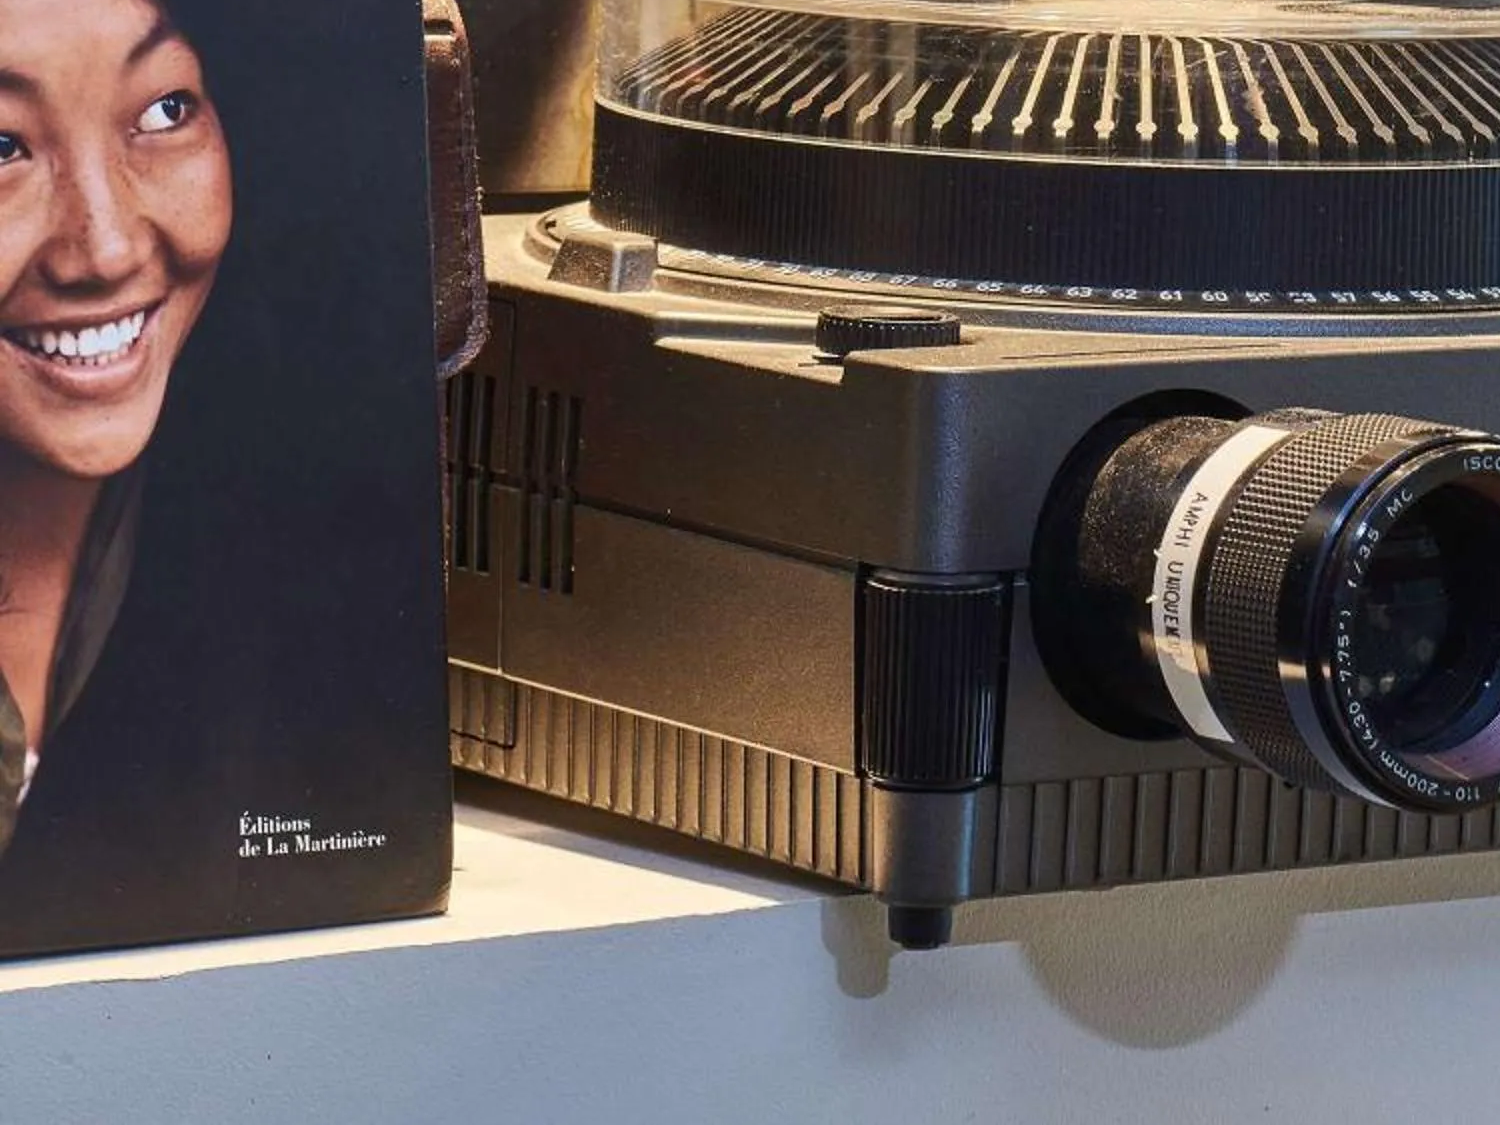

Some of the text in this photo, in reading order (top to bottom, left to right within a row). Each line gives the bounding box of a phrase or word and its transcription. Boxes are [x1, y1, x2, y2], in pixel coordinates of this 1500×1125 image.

[1021, 284, 1047, 295] 64
[1066, 286, 1093, 298] 63
[1111, 288, 1138, 300] 62
[1159, 290, 1183, 301] 61
[1201, 290, 1229, 302] 60
[238, 810, 312, 836] Éditions
[238, 829, 387, 858] de La Martinière
